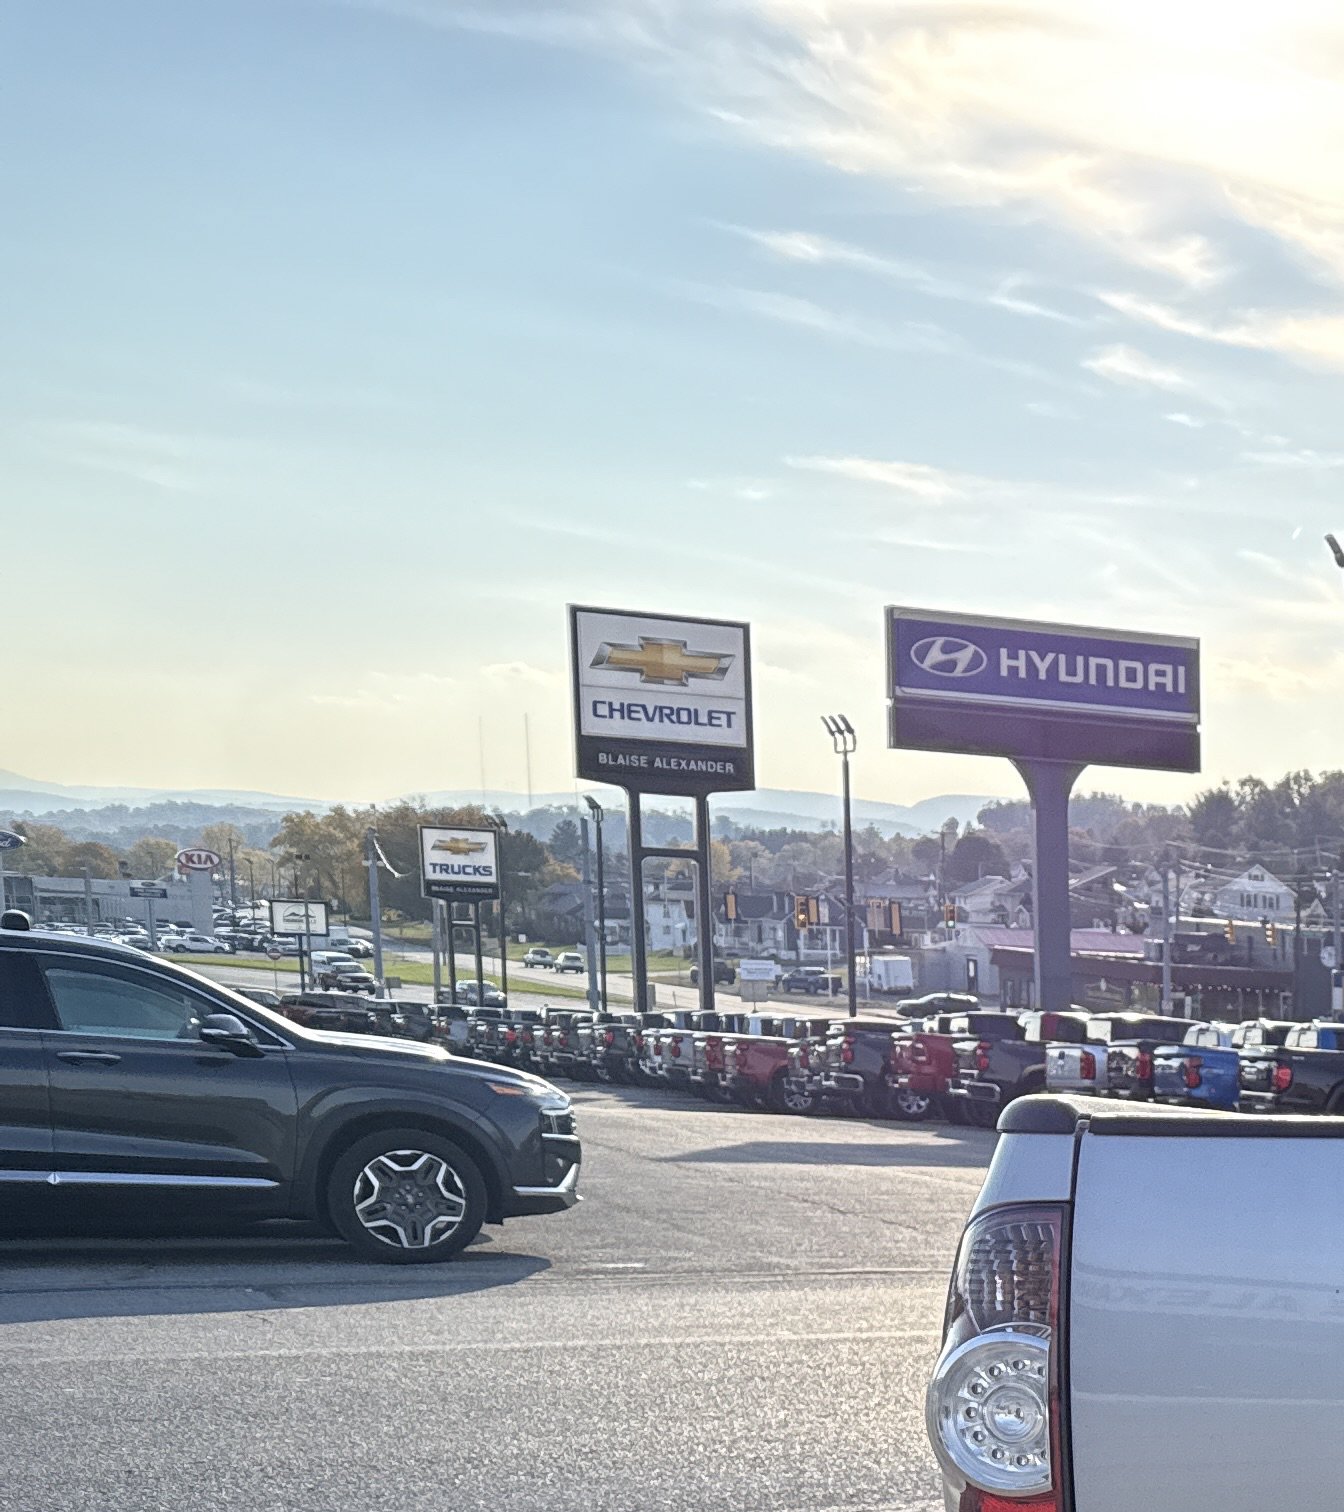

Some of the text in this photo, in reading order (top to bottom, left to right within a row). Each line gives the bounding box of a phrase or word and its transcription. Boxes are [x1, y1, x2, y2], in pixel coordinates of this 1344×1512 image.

[1000, 647, 1185, 694] HYUNDAI
[592, 700, 737, 729] CHEVROLET
[598, 752, 735, 774] BLAISE ALEXANDER
[184, 853, 215, 866] KIA
[429, 862, 493, 877] TRUCKS
